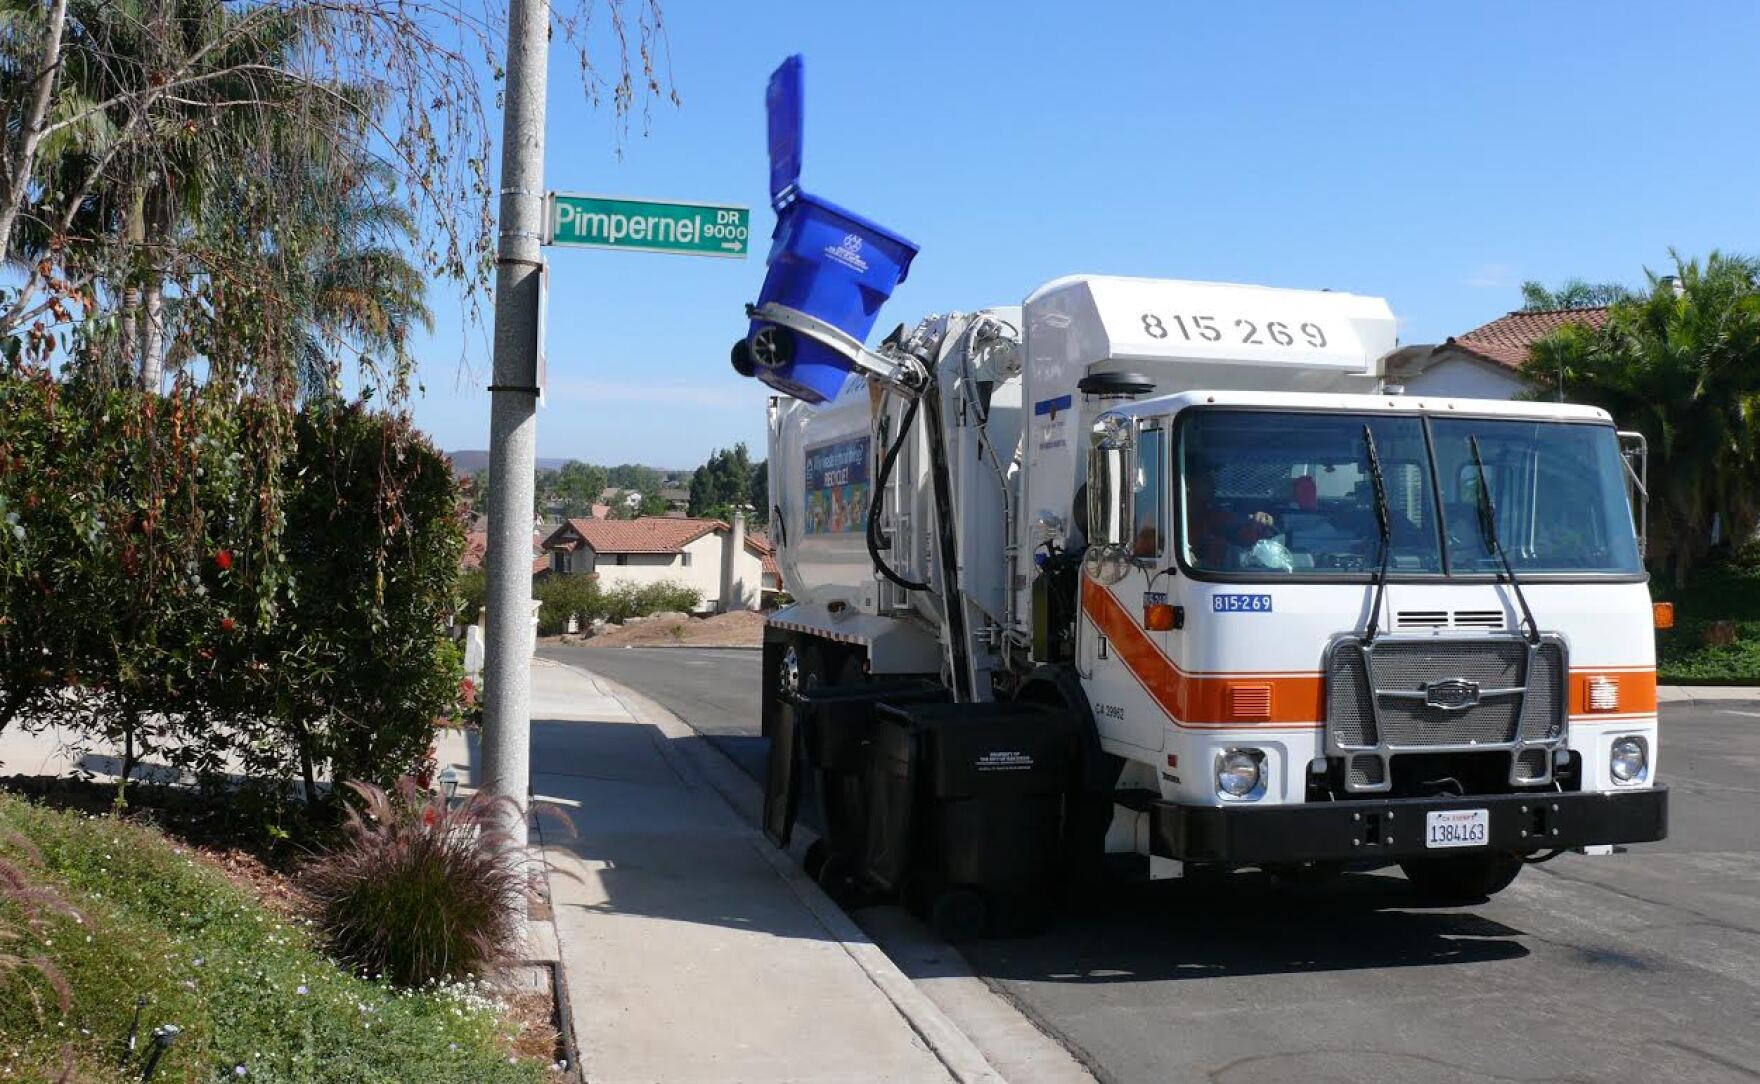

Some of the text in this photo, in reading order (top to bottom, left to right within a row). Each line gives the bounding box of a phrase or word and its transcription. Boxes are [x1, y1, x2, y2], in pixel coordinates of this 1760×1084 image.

[554, 203, 700, 243] Pimpernel
[717, 210, 739, 225] DR
[703, 225, 747, 240] 9000
[1140, 313, 1328, 348] 815 269
[1215, 596, 1271, 610] 815-269
[1431, 823, 1484, 842] 1384163
